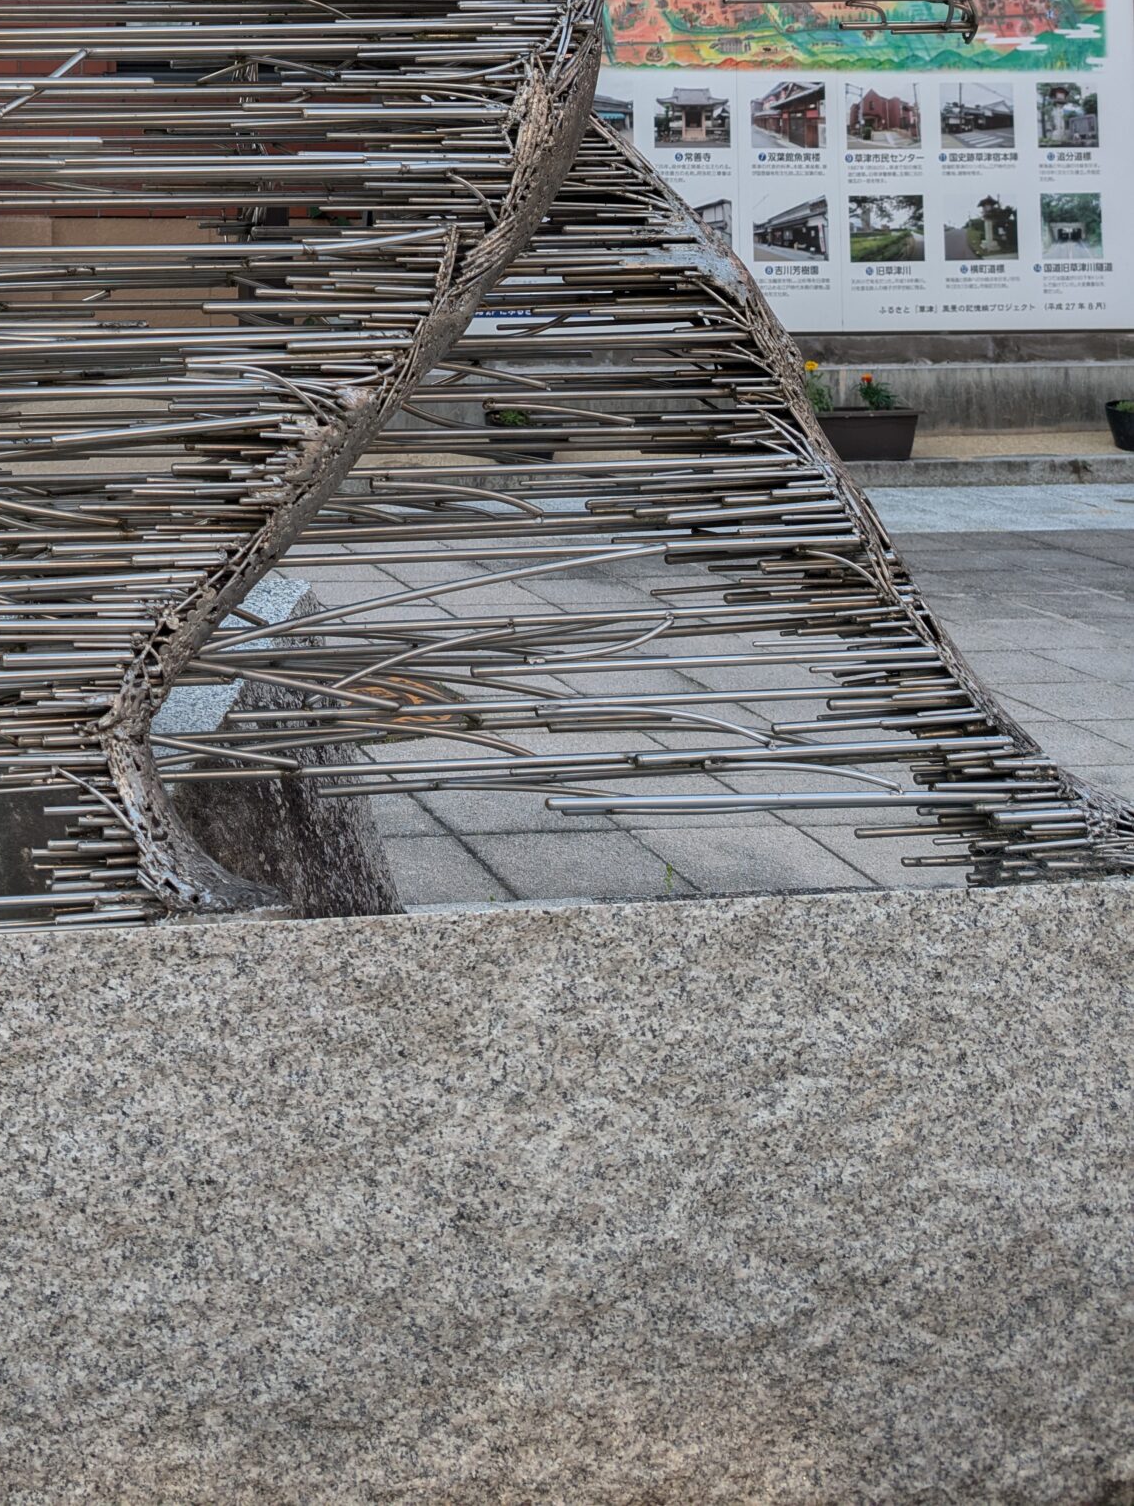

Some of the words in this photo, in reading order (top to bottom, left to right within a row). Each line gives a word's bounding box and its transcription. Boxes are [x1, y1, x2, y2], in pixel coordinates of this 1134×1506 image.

[684, 151, 711, 162] 常善寺
[854, 153, 924, 163] 草津市民センター
[876, 265, 911, 276] 旧草津川
